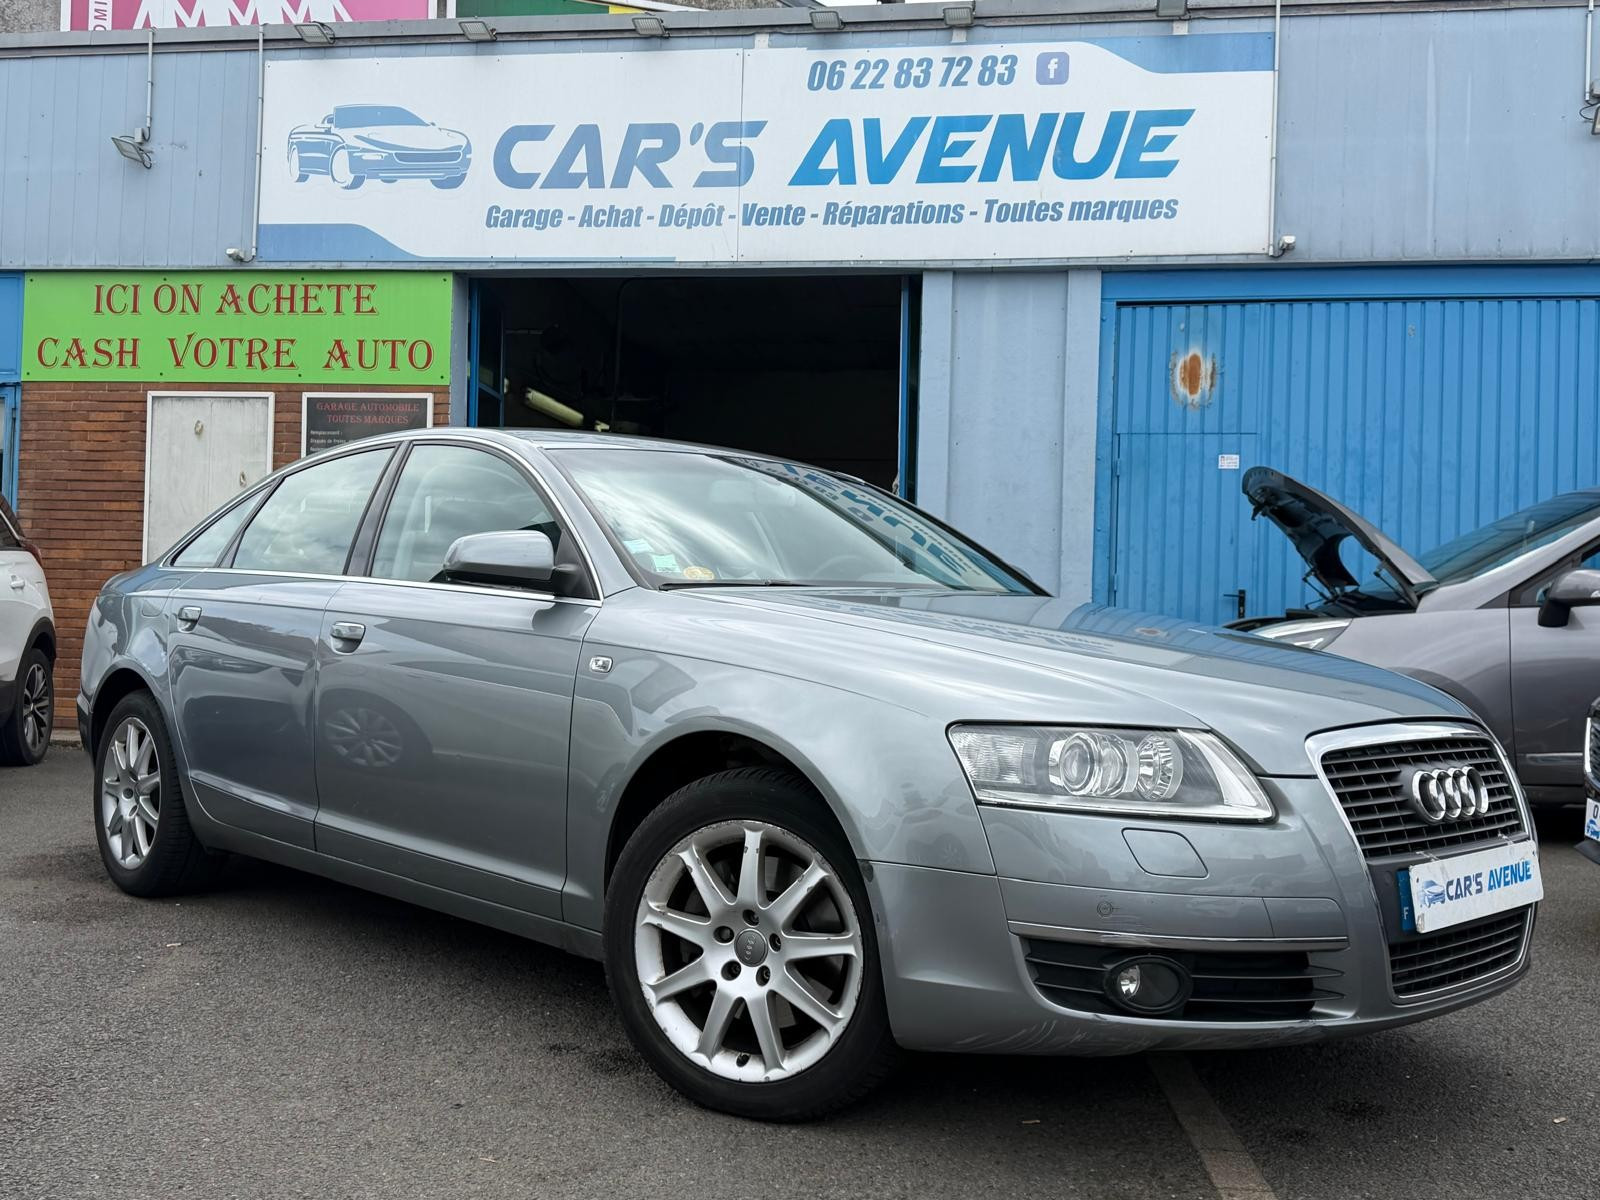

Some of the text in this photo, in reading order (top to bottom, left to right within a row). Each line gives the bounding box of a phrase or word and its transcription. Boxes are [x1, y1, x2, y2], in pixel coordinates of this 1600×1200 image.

[806, 54, 1019, 92] 06 22 83 72 83
[492, 108, 1197, 191] CAR'S AVENUE
[484, 204, 563, 231] Garage
[578, 204, 644, 228] Achat
[658, 202, 726, 230] Dépôt
[741, 202, 807, 227] Vente
[822, 200, 965, 229] Réparations
[984, 198, 1064, 224] Toutes
[1067, 198, 1179, 223] marques
[94, 282, 377, 314] ICI ON ACHETE
[37, 333, 434, 370] CASH VOTRE AUTO
[316, 402, 420, 412] GARAGE AUTOMOBILE
[327, 414, 409, 424] TOUTES MARQUES
[1446, 860, 1532, 901] CAR'S AVENUE
[1403, 906, 1409, 920] F
